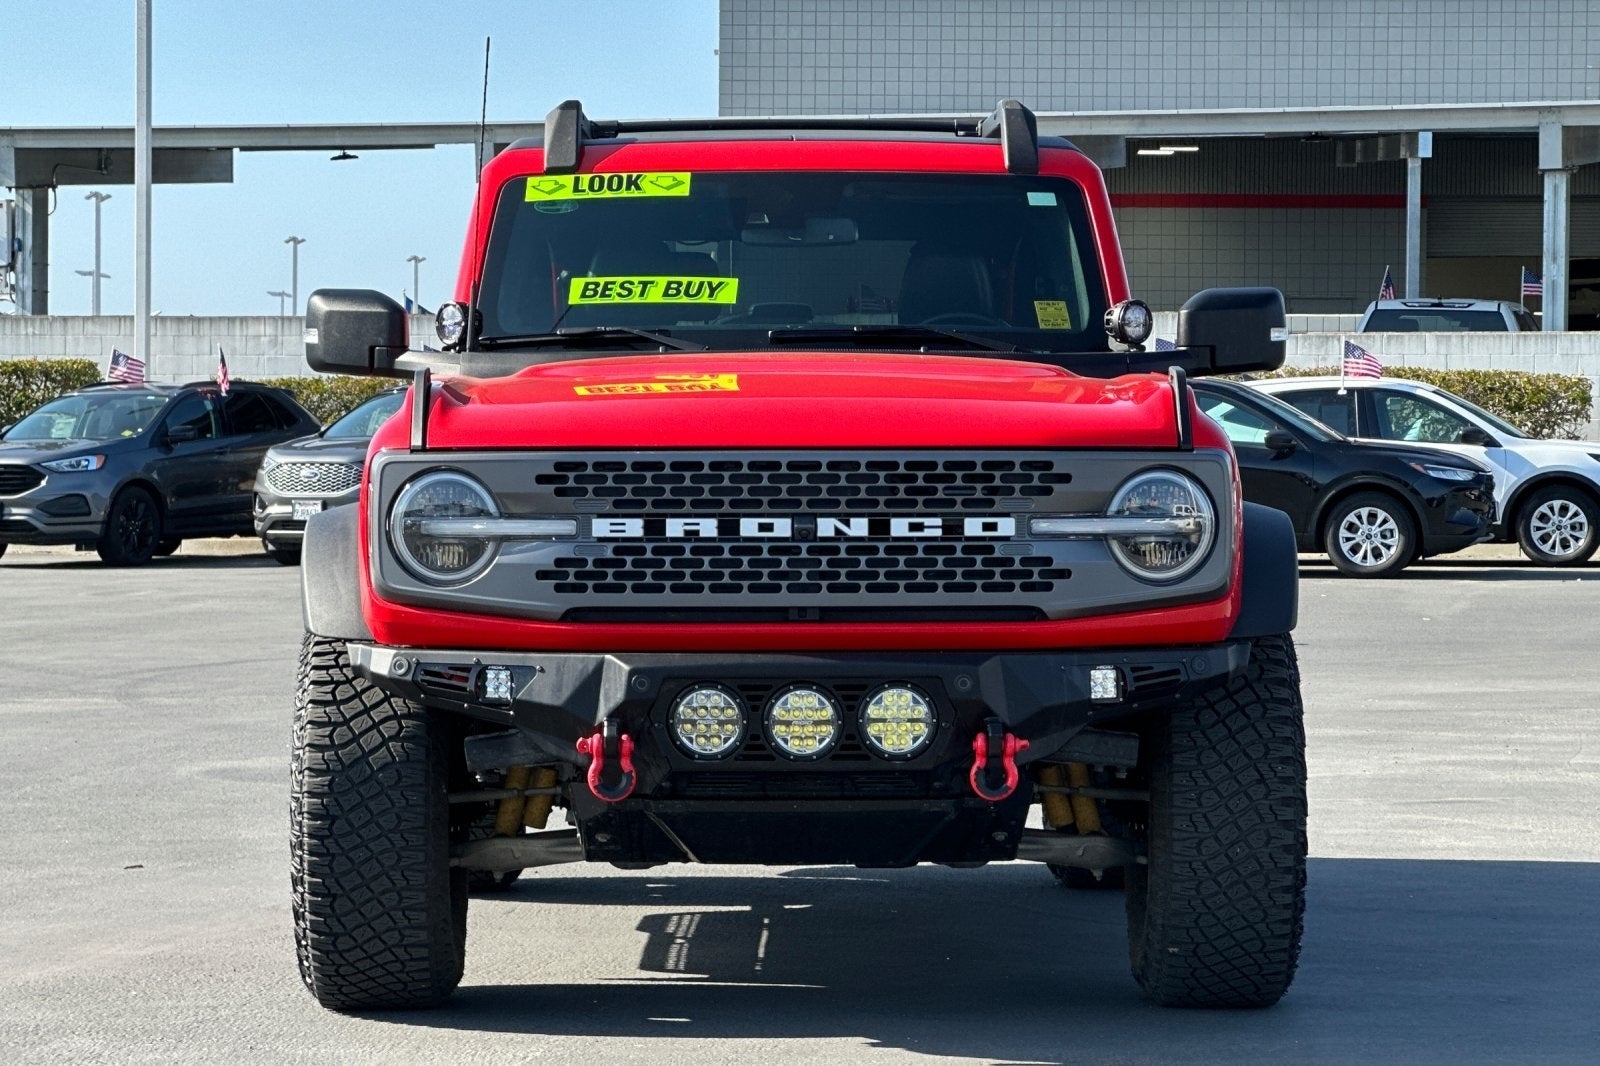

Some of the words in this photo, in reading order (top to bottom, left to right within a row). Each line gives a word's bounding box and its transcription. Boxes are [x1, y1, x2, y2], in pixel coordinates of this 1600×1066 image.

[572, 174, 646, 195] LOOK
[579, 280, 657, 301] BEST
[661, 280, 727, 301] BUY
[592, 517, 1016, 538] BRONCO
